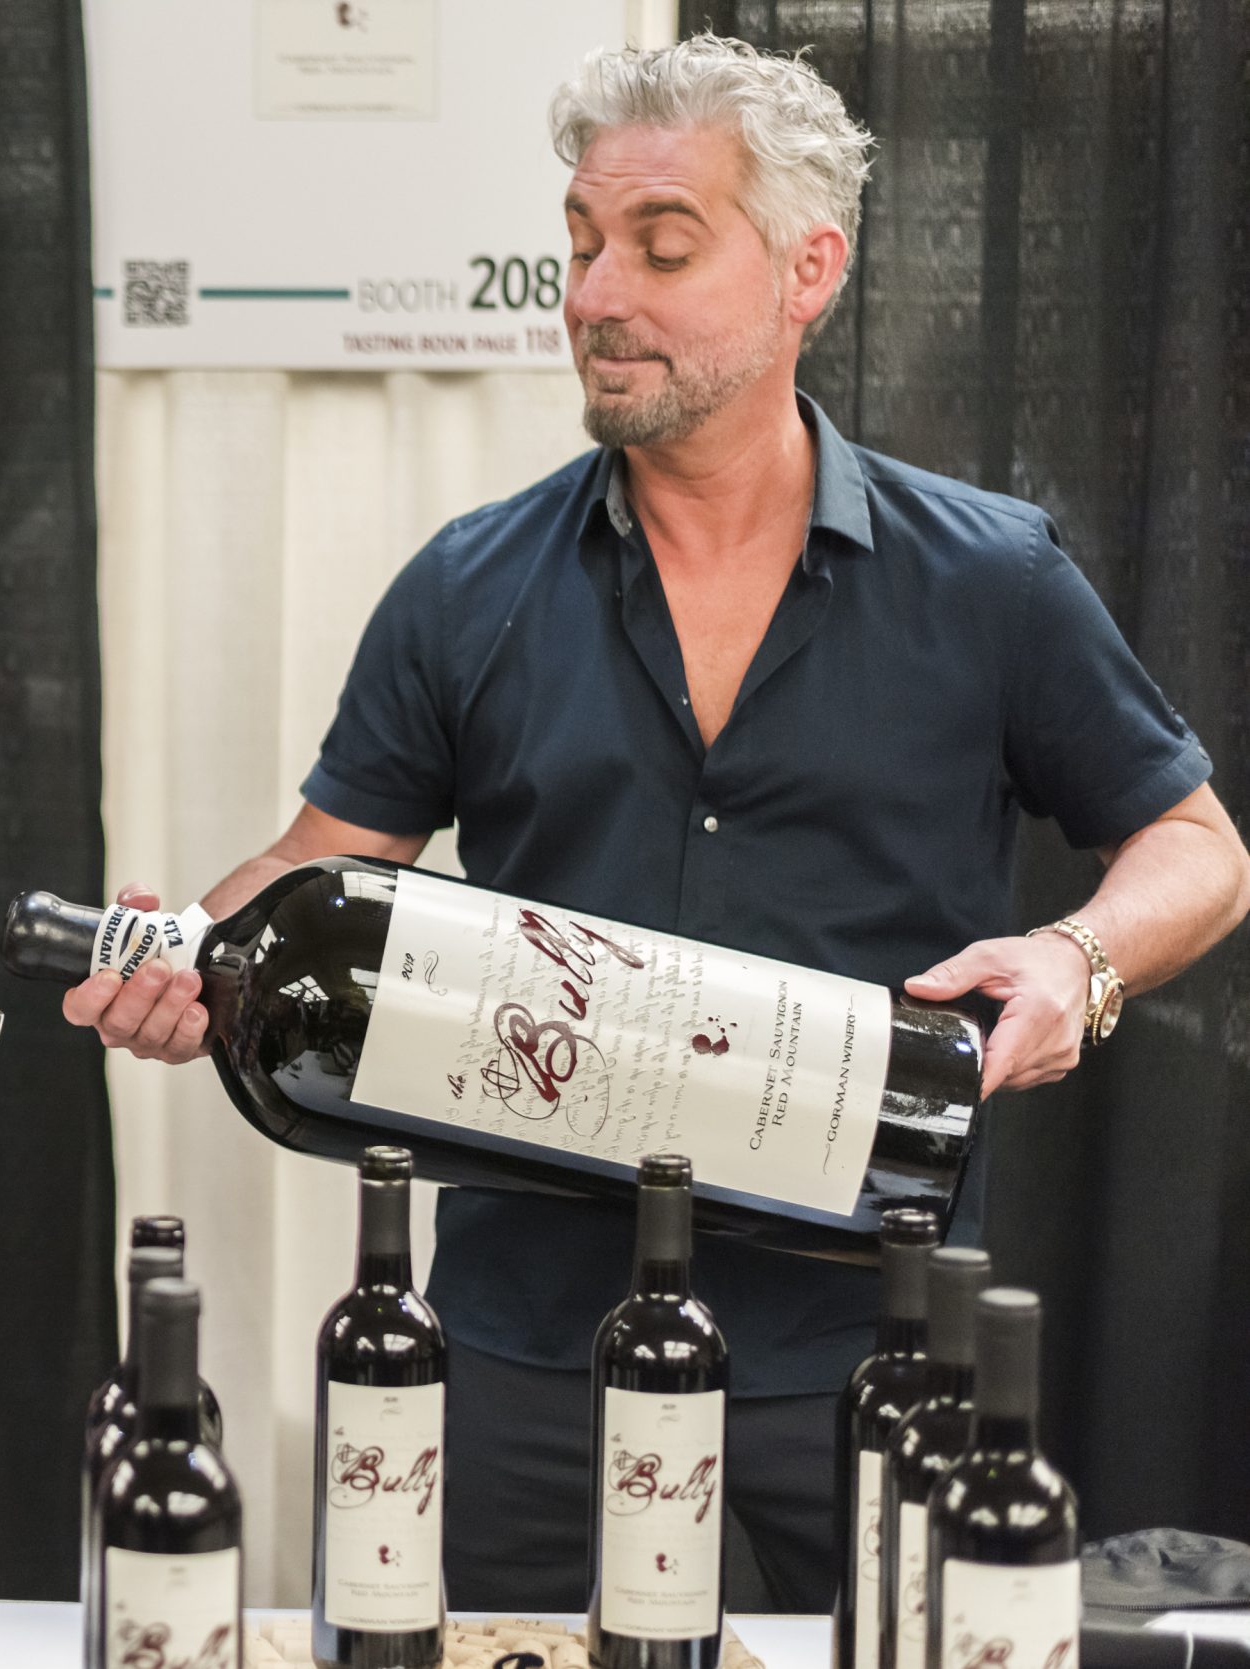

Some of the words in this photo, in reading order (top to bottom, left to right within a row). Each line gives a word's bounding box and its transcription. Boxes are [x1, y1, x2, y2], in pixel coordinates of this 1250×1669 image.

[357, 277, 459, 313] BOOTH
[469, 255, 562, 310] 208
[342, 333, 415, 353] TASTING
[418, 333, 468, 353] BOOK
[471, 333, 518, 353] PAGE
[488, 908, 645, 1108] Bully
[749, 1064, 778, 1151] CABERNET
[769, 979, 788, 1060] SAUVIGNON
[771, 1092, 789, 1127] RED
[781, 1001, 803, 1087] MOUNTAIN
[827, 1066, 850, 1142] GORMAN
[842, 1012, 856, 1064] WINERY
[333, 1445, 439, 1516] Bully
[611, 1452, 718, 1524] Bully
